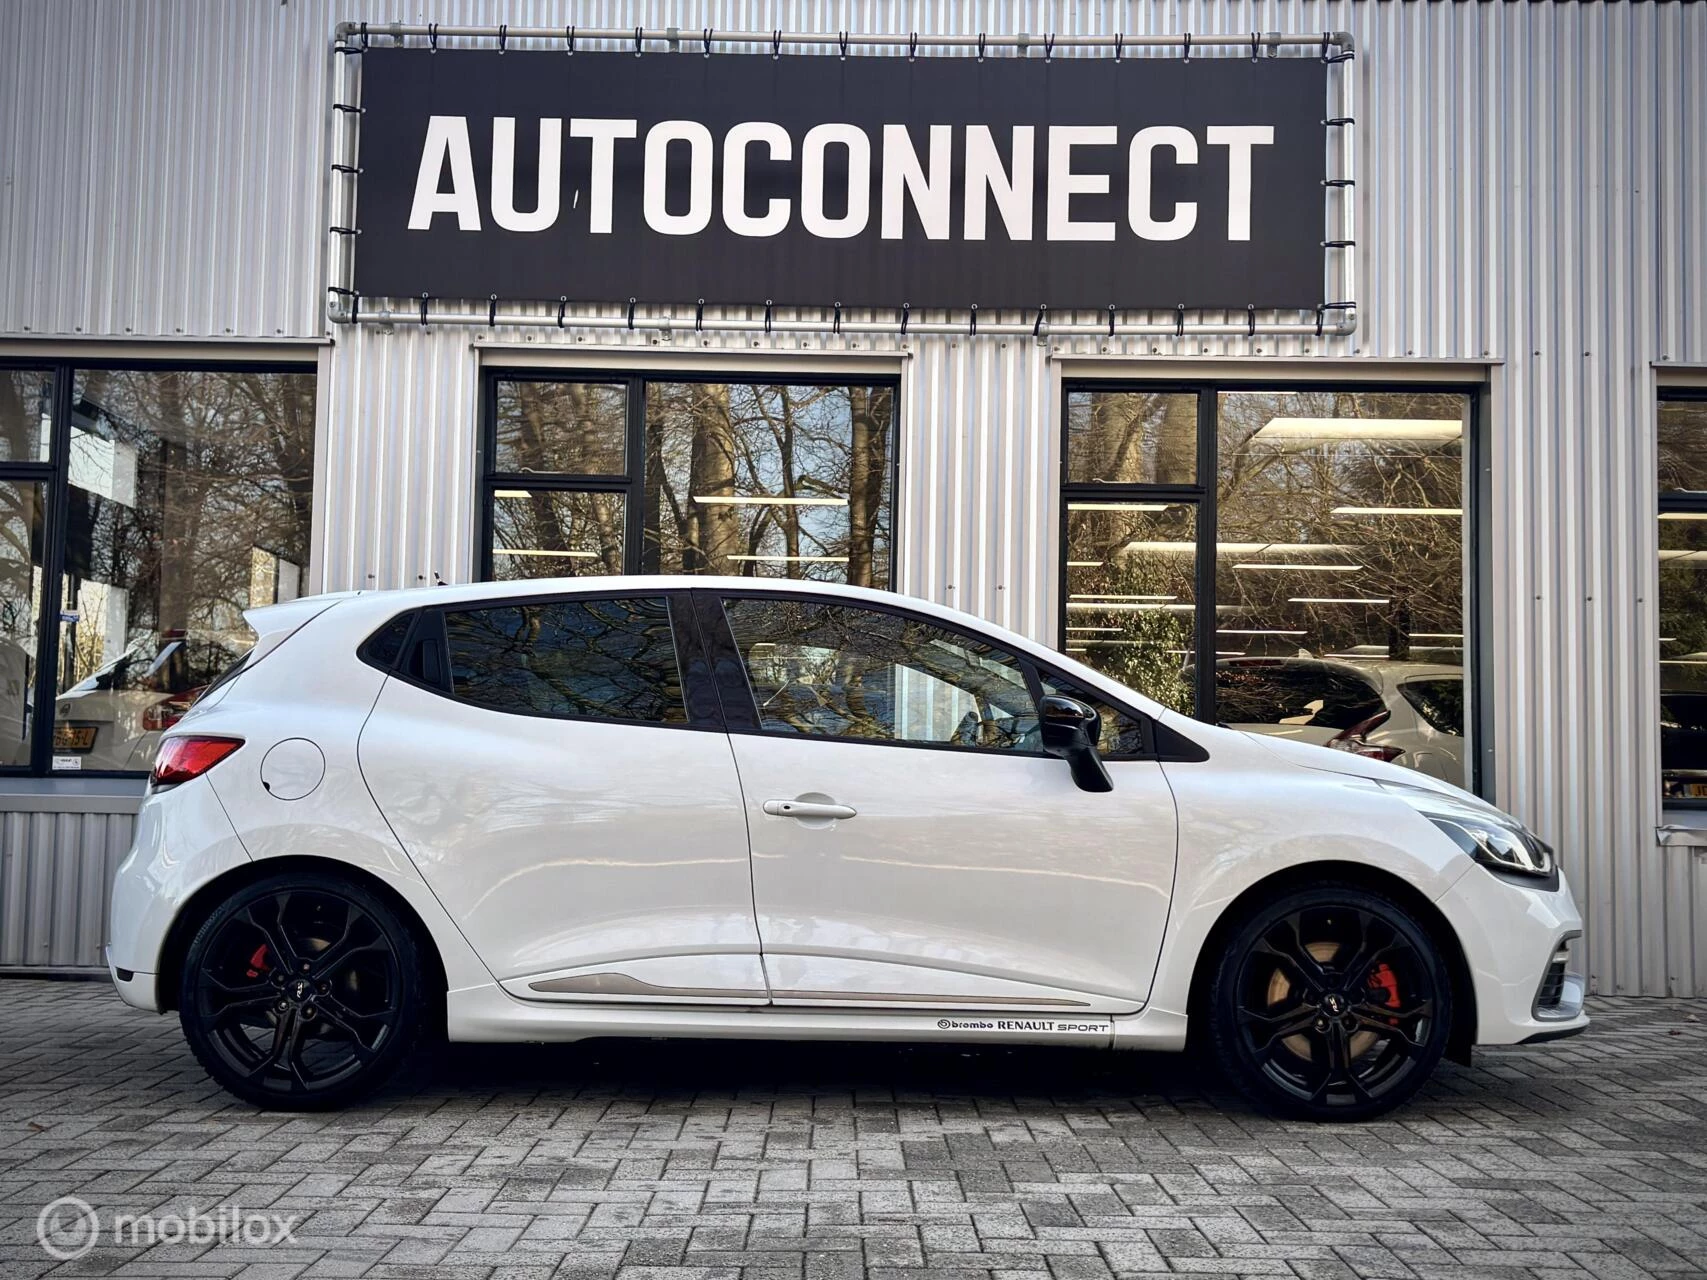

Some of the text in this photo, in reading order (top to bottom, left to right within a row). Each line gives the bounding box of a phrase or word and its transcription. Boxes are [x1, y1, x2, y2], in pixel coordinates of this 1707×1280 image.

[408, 115, 1274, 241] AUTOCONNECT
[997, 1020, 1054, 1031] RENAULT
[1057, 1023, 1109, 1032] SPORT
